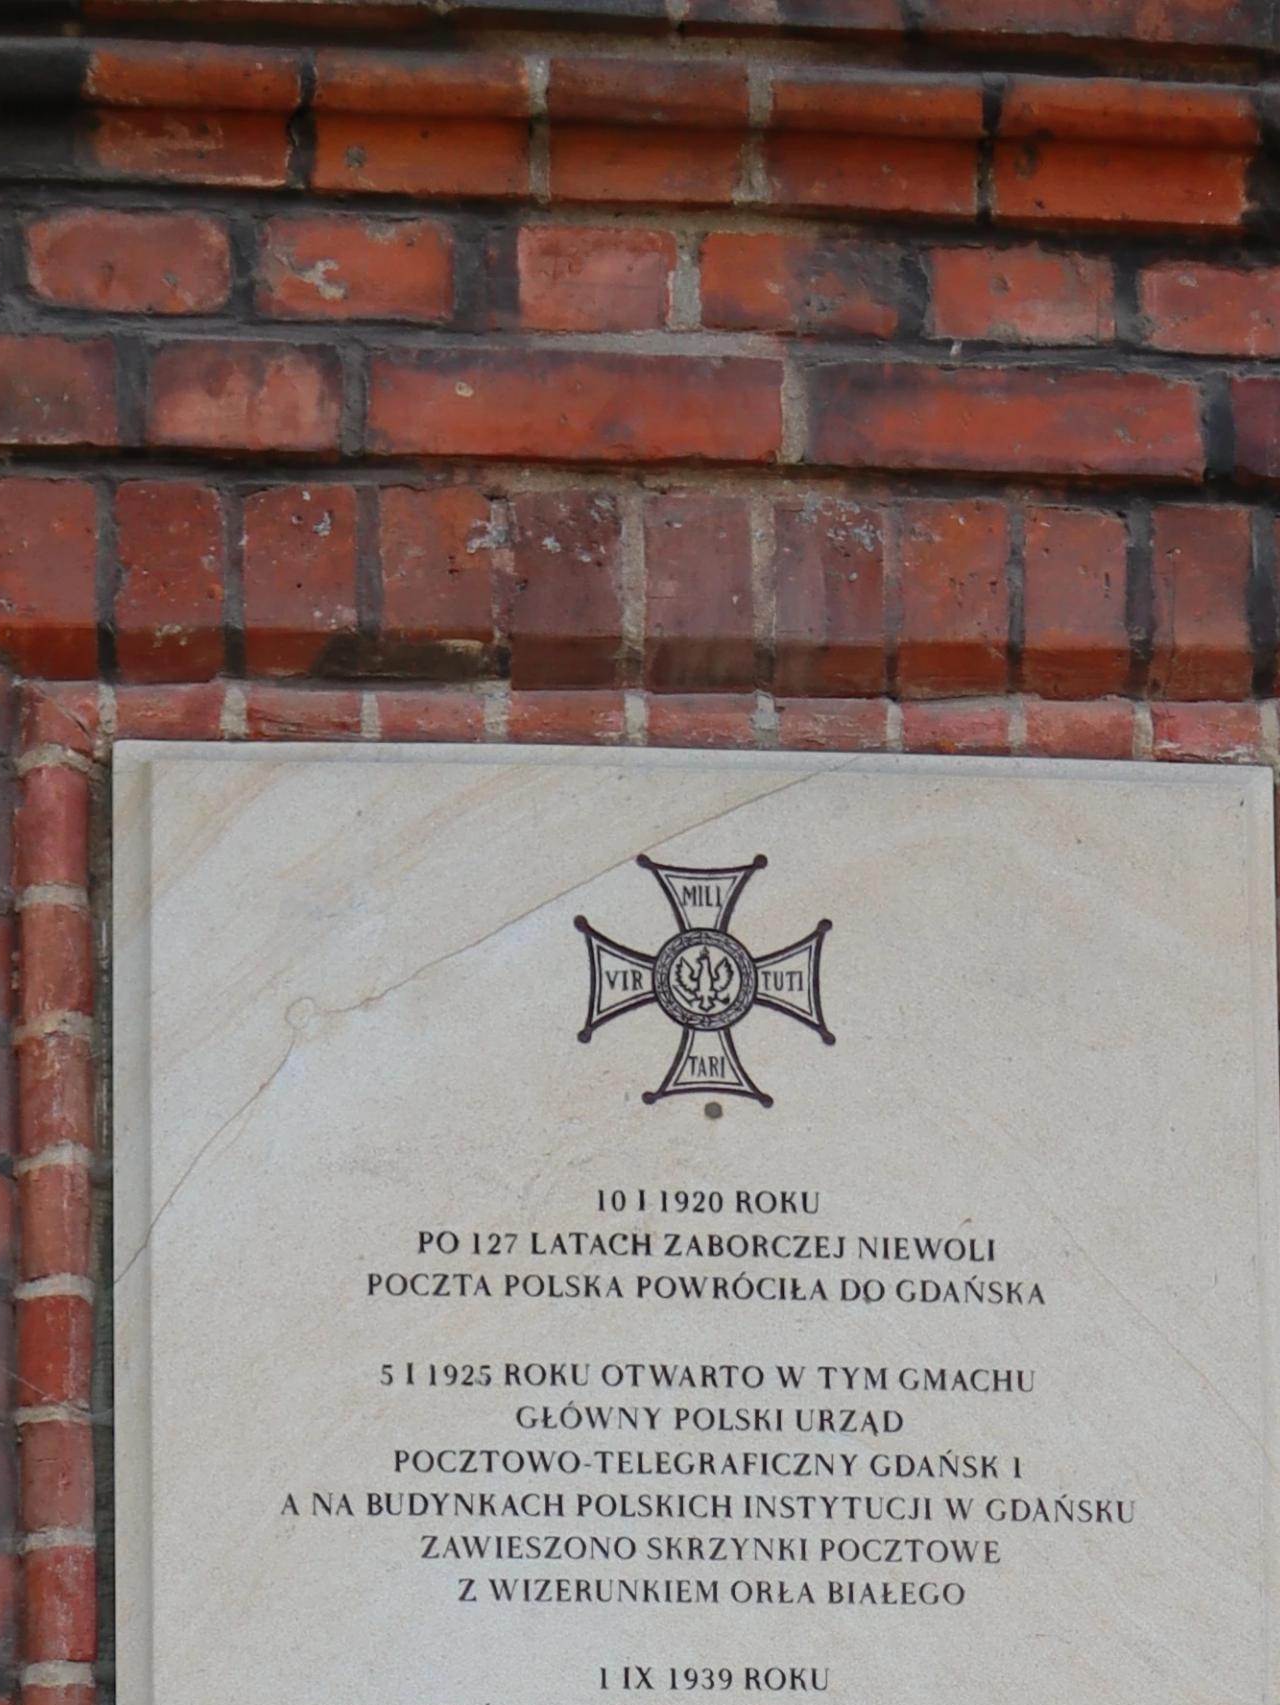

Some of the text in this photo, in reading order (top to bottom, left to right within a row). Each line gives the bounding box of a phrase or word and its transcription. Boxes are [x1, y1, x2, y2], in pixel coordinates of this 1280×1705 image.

[682, 884, 722, 908] MILI
[605, 970, 644, 992] VIR
[761, 971, 804, 992] TUTI
[687, 1055, 726, 1079] TARI
[597, 1188, 819, 1215] 10 I 1920 ROKU
[417, 1230, 995, 1263] PO 127 LATACH ZABORCZEJ NIEWOLI
[367, 1271, 1046, 1305] POCZTA POLSKA POWRÓCIŁA DO GDAŃSKA
[515, 1400, 904, 1437] GŁÓWNY POLSKI URZĄD
[280, 1492, 1135, 1524] A NA BUDYNKACH POLSKICH INSTYTUCJI W GDAŃSKU
[420, 1534, 1001, 1564] ZAWIESZONO SKRZYNKI POCZTOWE
